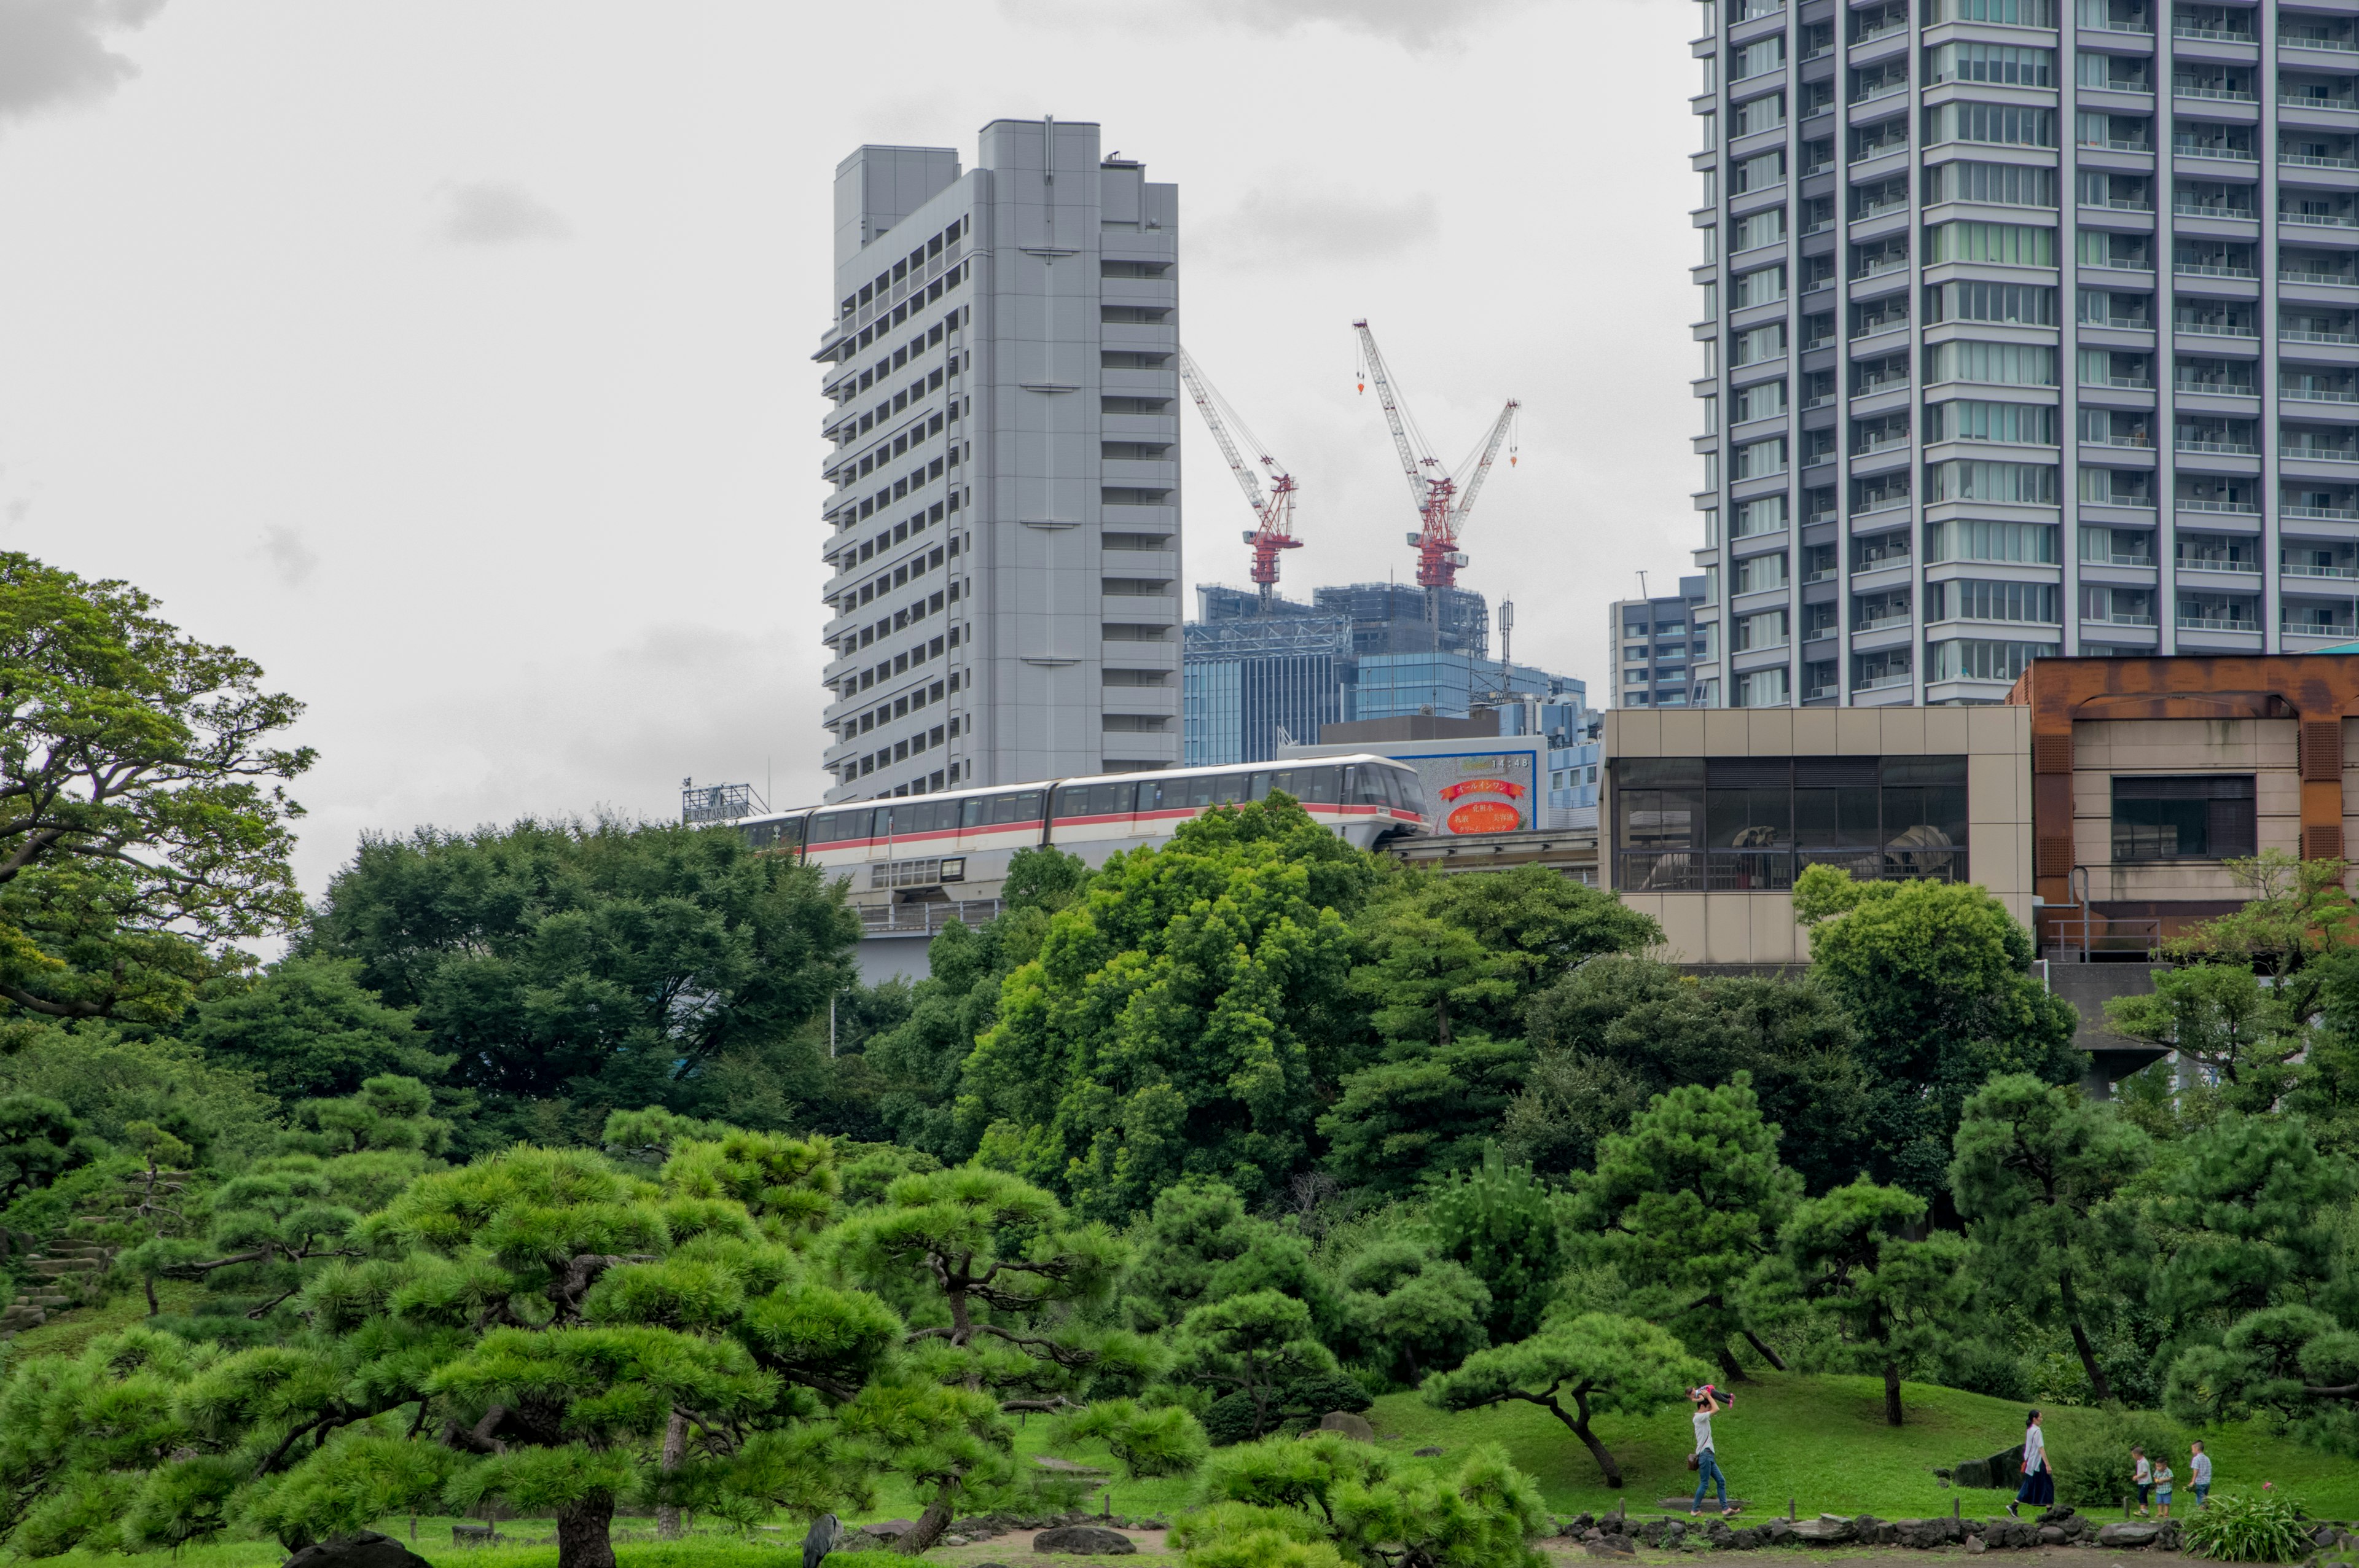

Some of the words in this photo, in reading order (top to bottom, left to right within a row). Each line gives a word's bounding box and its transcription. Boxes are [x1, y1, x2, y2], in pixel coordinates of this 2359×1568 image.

[1492, 759, 1528, 768] 14:48
[1457, 781, 1506, 793] オールインワン
[685, 807, 727, 821] URETAKE
[730, 805, 746, 816] INN
[1493, 813, 1514, 821] 美容液
